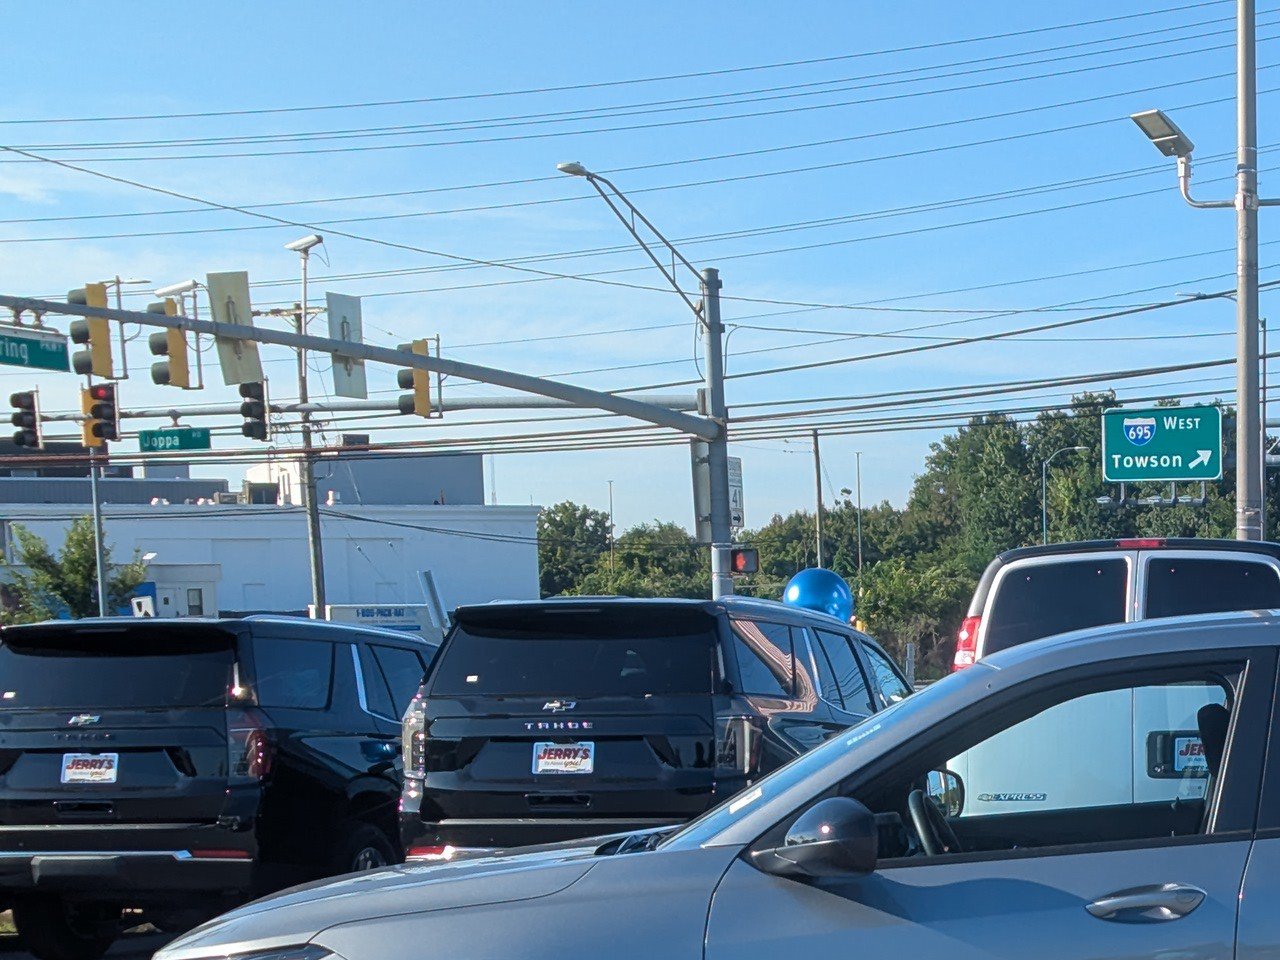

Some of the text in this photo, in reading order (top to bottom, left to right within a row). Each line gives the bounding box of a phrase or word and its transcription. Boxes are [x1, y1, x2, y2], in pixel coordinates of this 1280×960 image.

[1128, 416, 1201, 440] 695 WEST
[143, 434, 180, 449] Joppa
[1112, 454, 1182, 469] Towson
[525, 721, 593, 730] TAHOE
[537, 747, 591, 760] JERRY'S
[65, 758, 115, 770] JERRY'S
[992, 792, 1047, 802] EXPRESS
